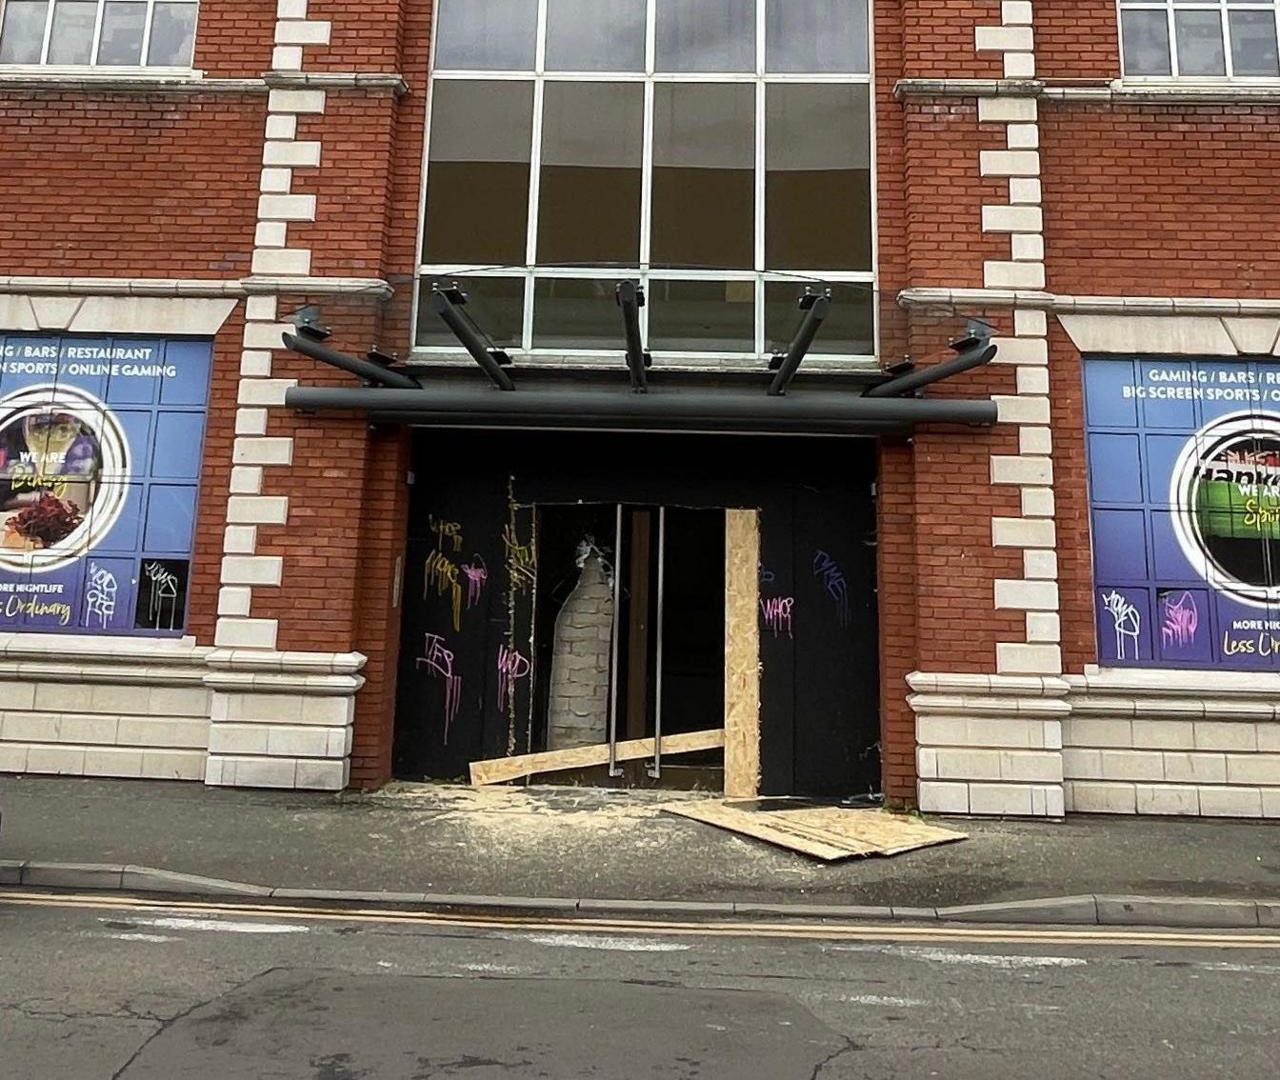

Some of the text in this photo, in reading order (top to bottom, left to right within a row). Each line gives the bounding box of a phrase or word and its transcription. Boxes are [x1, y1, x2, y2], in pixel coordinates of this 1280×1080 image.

[24, 346, 57, 358] BARS
[68, 347, 152, 360] RESTAURANT
[10, 363, 58, 375] SPORTS
[68, 364, 119, 376] ONLINE
[121, 365, 176, 377] GAMING
[1149, 369, 1207, 382] GAMING
[1219, 372, 1255, 383] BARS
[1122, 386, 1146, 398] BIG
[1149, 386, 1204, 399] SCREEN
[1207, 388, 1260, 401] SPORTS
[20, 452, 66, 463] WE ARE
[9, 465, 70, 497] Dining
[1238, 484, 1258, 496] WE
[1233, 620, 1262, 630] MORE
[1223, 631, 1254, 655] Less
